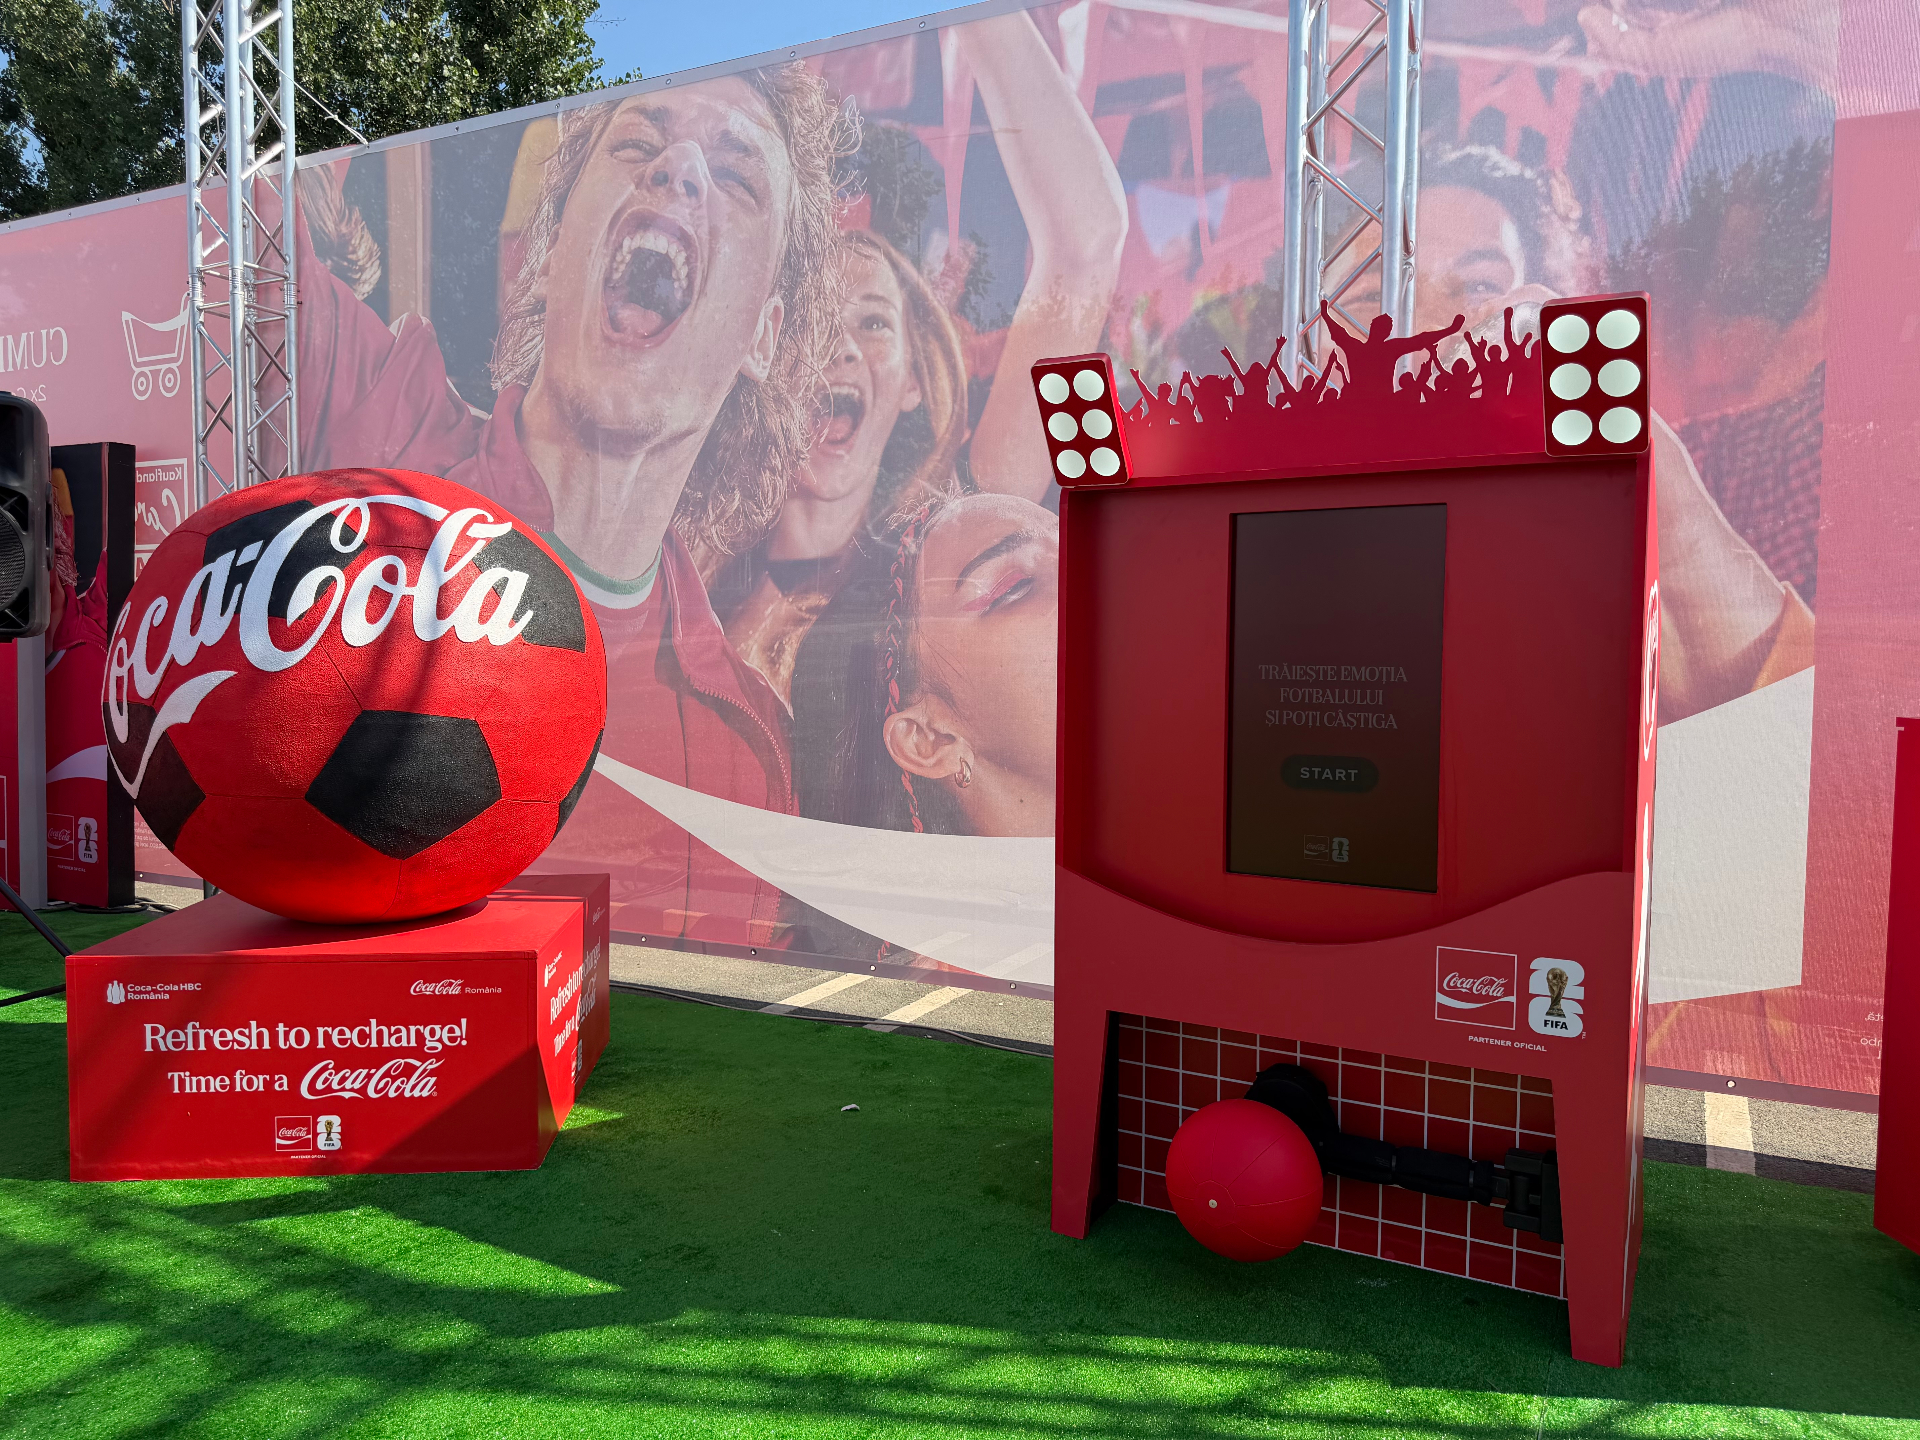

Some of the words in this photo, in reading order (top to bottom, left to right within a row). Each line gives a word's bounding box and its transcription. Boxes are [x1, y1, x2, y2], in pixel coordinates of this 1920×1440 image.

[1340, 665, 1408, 685] EMOȚIA
[1279, 687, 1384, 705] FOTBALULUI
[1265, 709, 1280, 727] ȘI
[1282, 710, 1321, 729] POȚI
[1300, 767, 1359, 782] START
[127, 983, 179, 992] Coca-Cola
[179, 982, 202, 991] HBC
[410, 979, 464, 995] Coca-Cola
[464, 986, 502, 994] România
[1442, 971, 1509, 998] Coca-Cola
[127, 991, 170, 1000] România
[1543, 1019, 1569, 1031] FIFA
[143, 1020, 271, 1052] Refresh
[275, 1022, 310, 1050] to
[316, 1018, 468, 1053] recharge!
[1468, 1035, 1512, 1047] PARTENER
[1513, 1041, 1547, 1052] OFICIAL
[167, 1071, 231, 1093] Time
[233, 1069, 270, 1092] for
[273, 1073, 289, 1091] a
[300, 1058, 445, 1100] Coca-Cola
[278, 1126, 308, 1138] Coca-Cola
